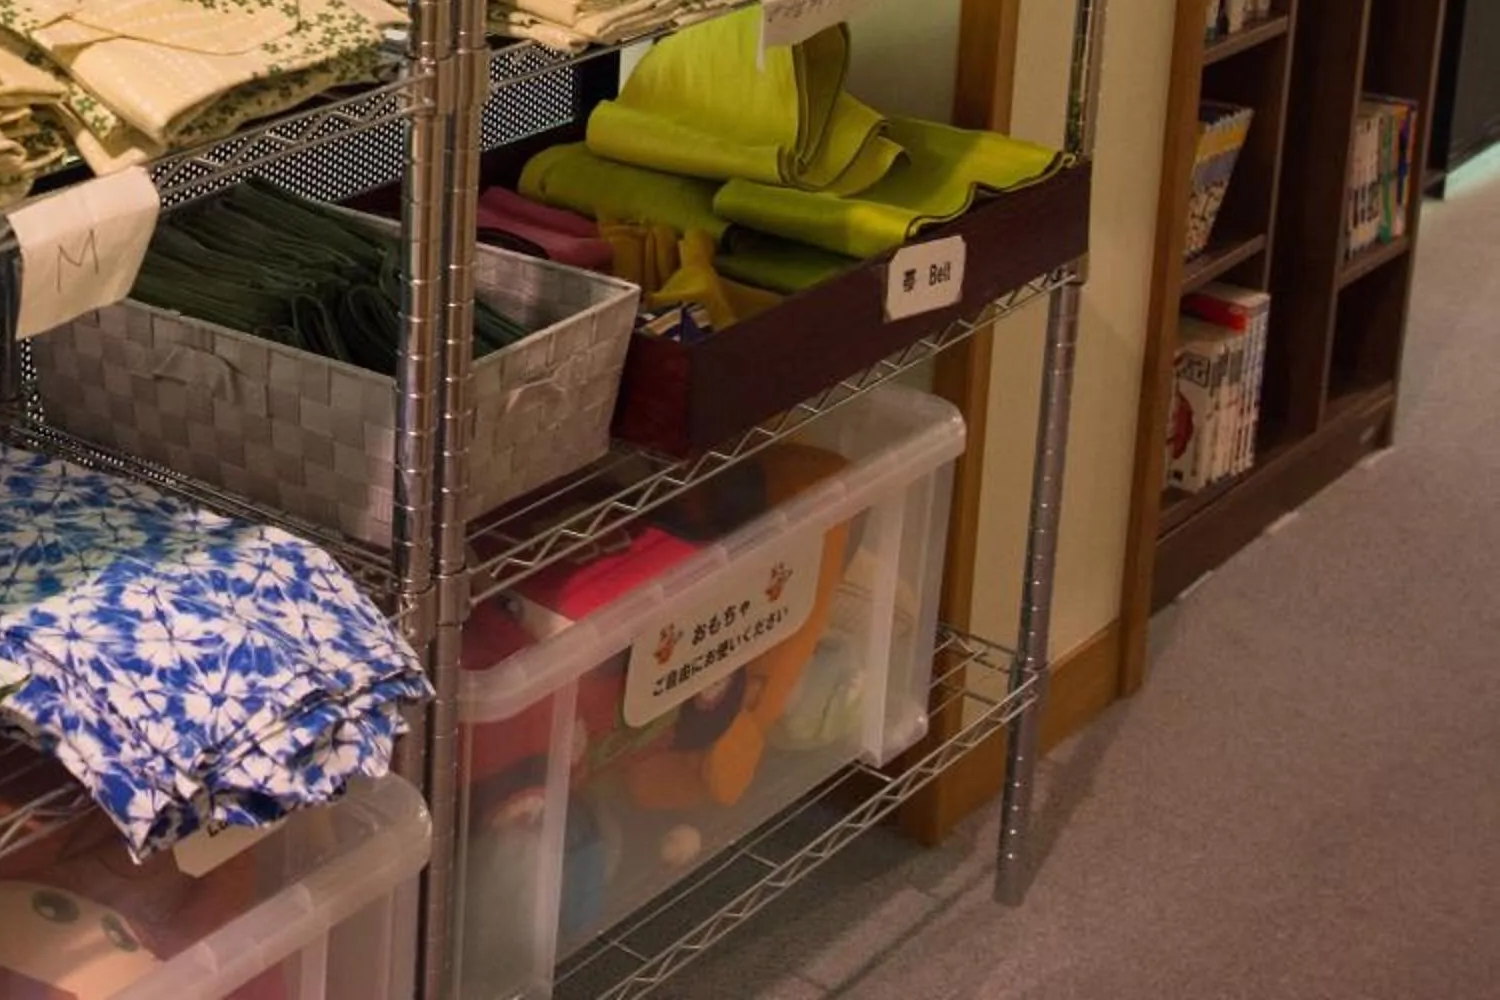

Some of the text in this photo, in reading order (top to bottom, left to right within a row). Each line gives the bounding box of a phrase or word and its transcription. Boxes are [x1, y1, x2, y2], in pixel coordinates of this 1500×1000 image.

[56, 228, 100, 294] M
[652, 606, 789, 697] ご自由にお使いください
[692, 600, 751, 646] おもちゃ
